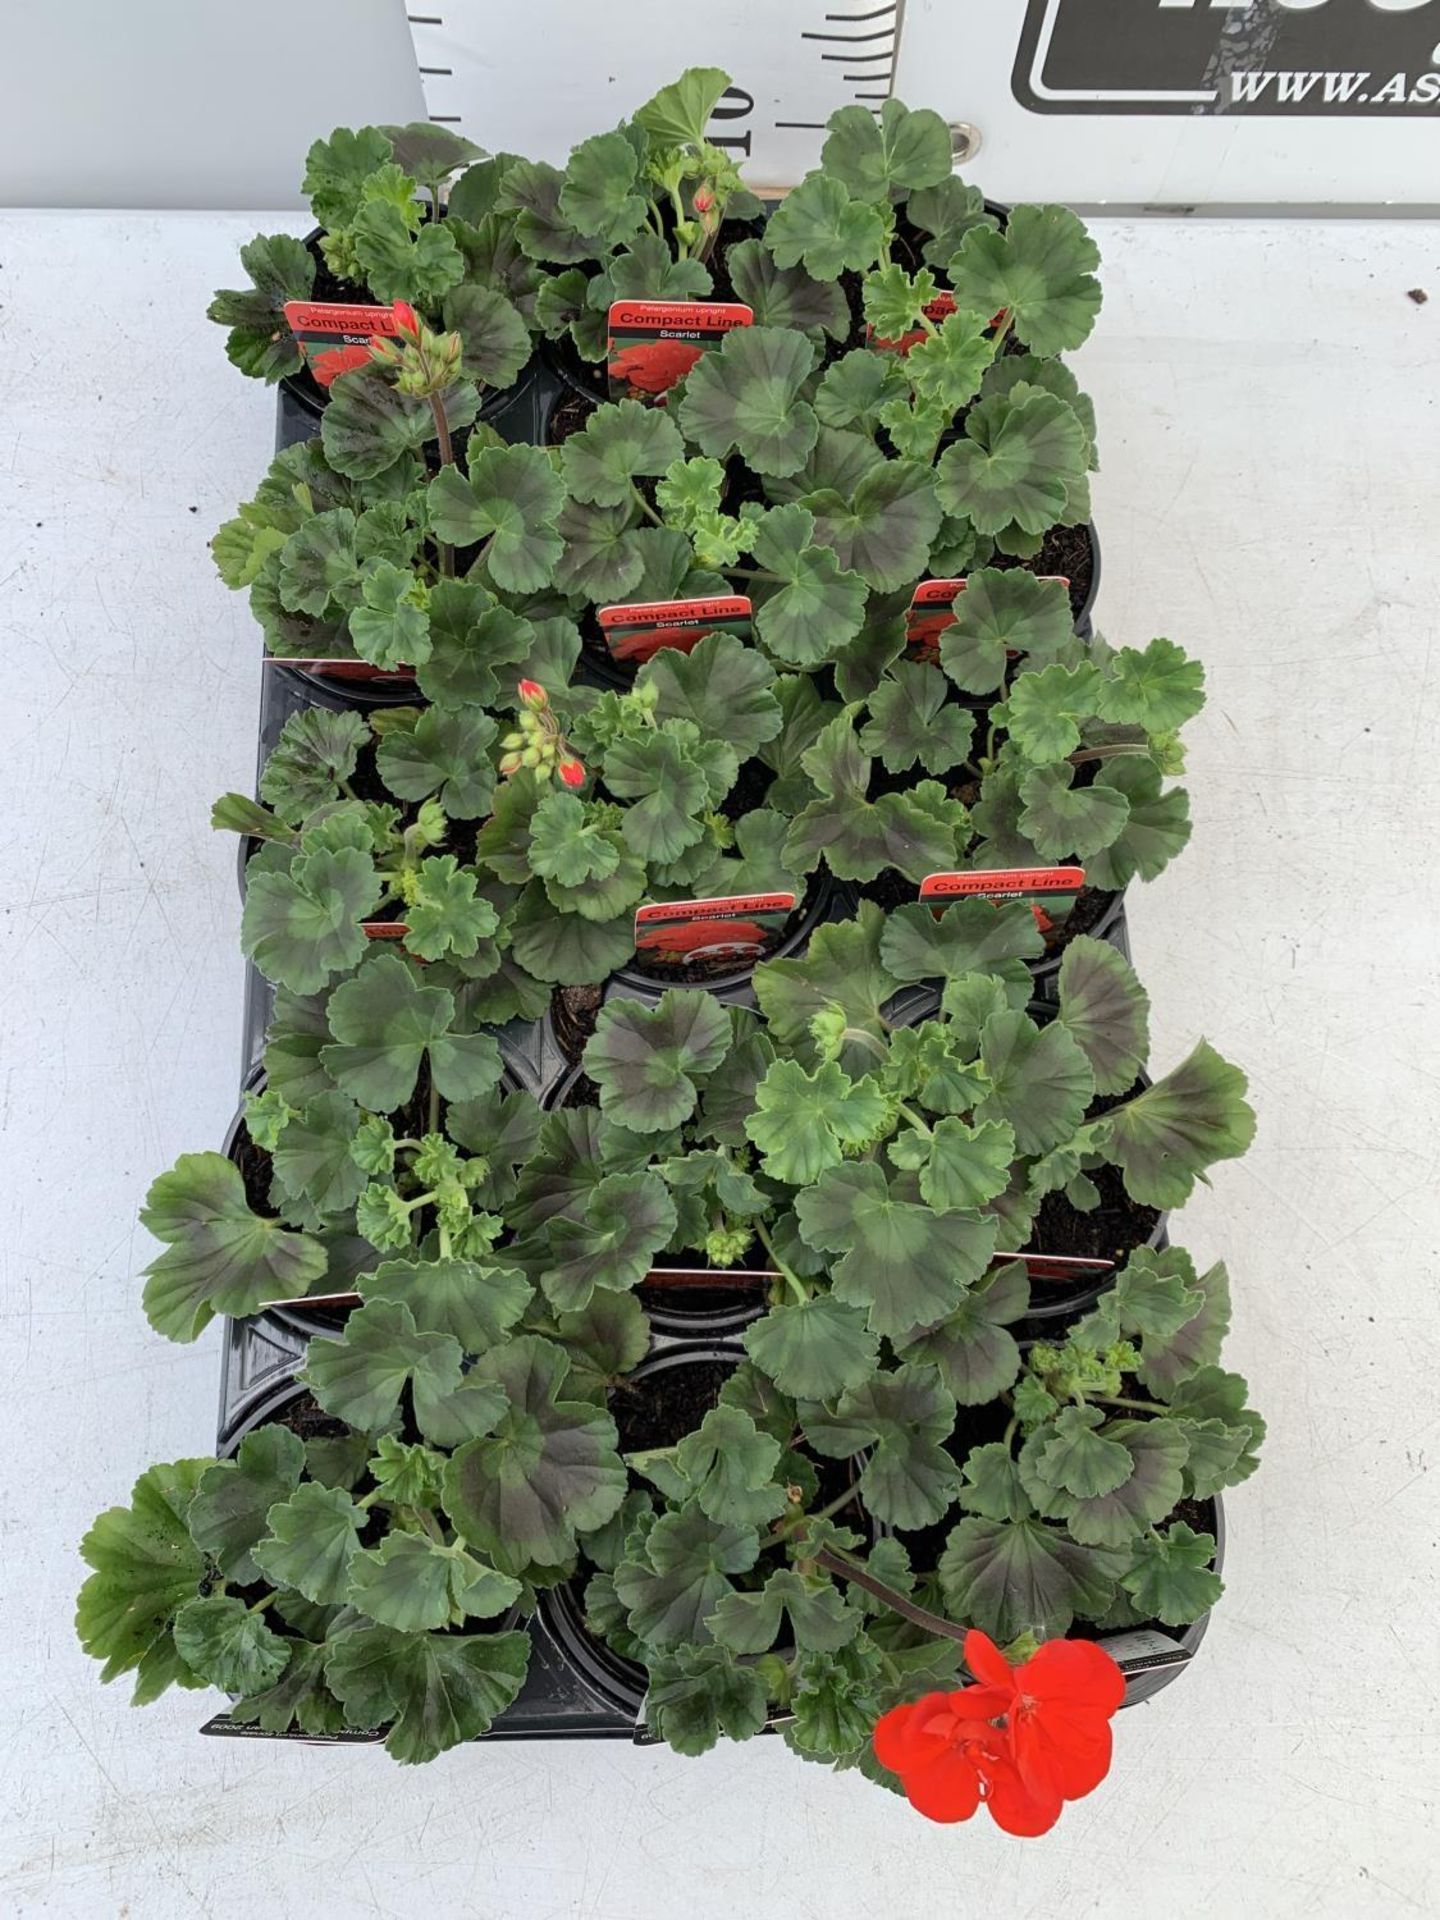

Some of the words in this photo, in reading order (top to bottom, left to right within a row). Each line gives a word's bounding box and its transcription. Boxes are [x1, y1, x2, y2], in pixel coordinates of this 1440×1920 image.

[703, 87, 754, 157] 10
[297, 315, 377, 331] Compact
[620, 313, 700, 326] Compact
[707, 316, 743, 327] Line
[660, 330, 701, 339] Scarlet
[611, 610, 695, 623] Compact
[703, 606, 741, 615] Line
[656, 619, 699, 628] Scarlet
[934, 879, 1025, 892] Compact
[1031, 878, 1074, 887] Line
[647, 905, 736, 918] Compact
[742, 901, 784, 910] Line
